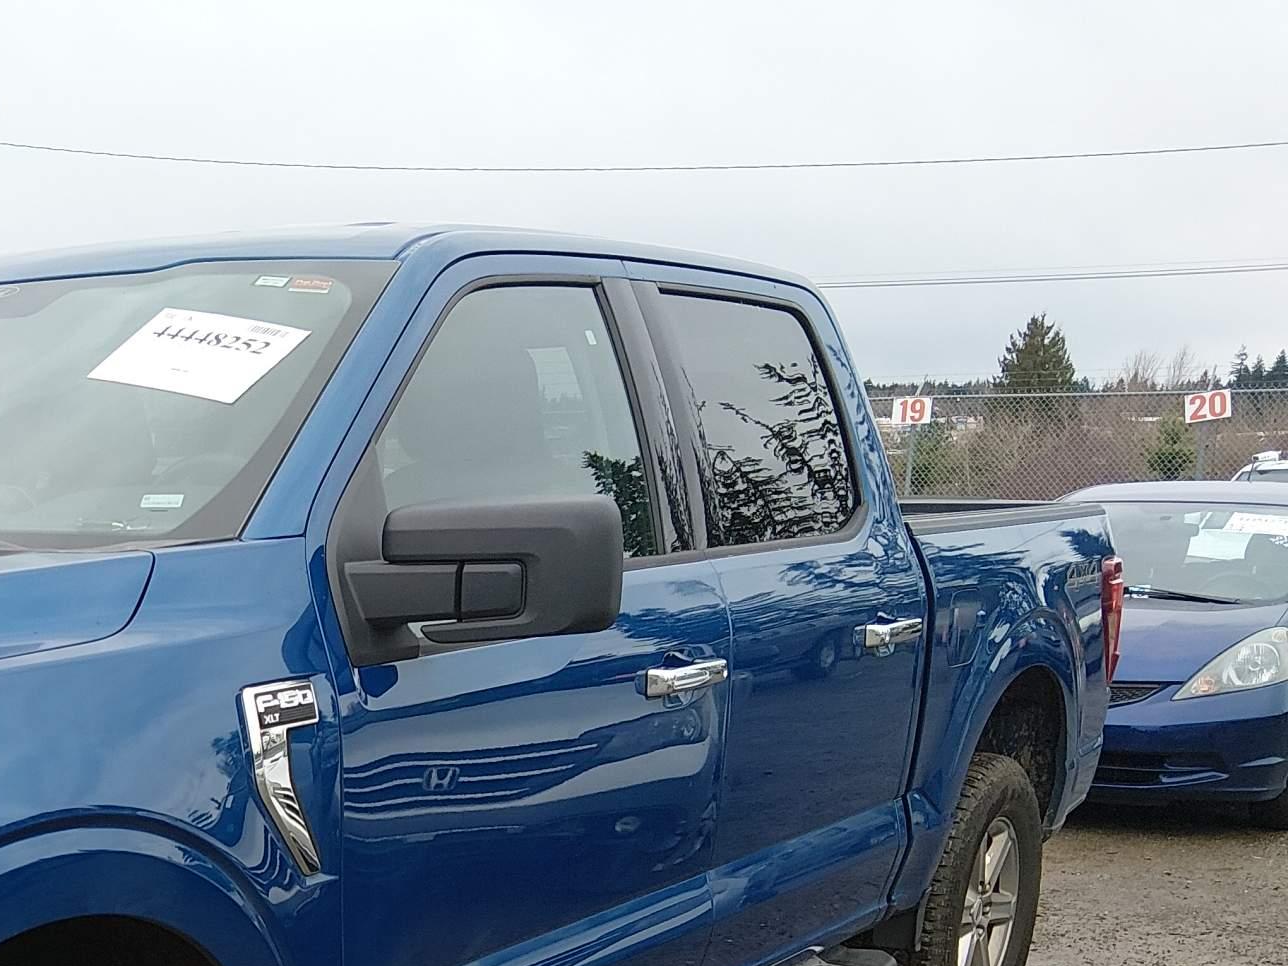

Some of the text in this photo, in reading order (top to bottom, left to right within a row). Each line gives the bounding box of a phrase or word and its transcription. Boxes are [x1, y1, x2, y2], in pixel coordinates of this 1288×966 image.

[152, 325, 271, 355] 44448252
[899, 398, 926, 423] 19
[1189, 391, 1227, 421] 20
[256, 689, 314, 713] F-150
[263, 713, 280, 725] XLT
